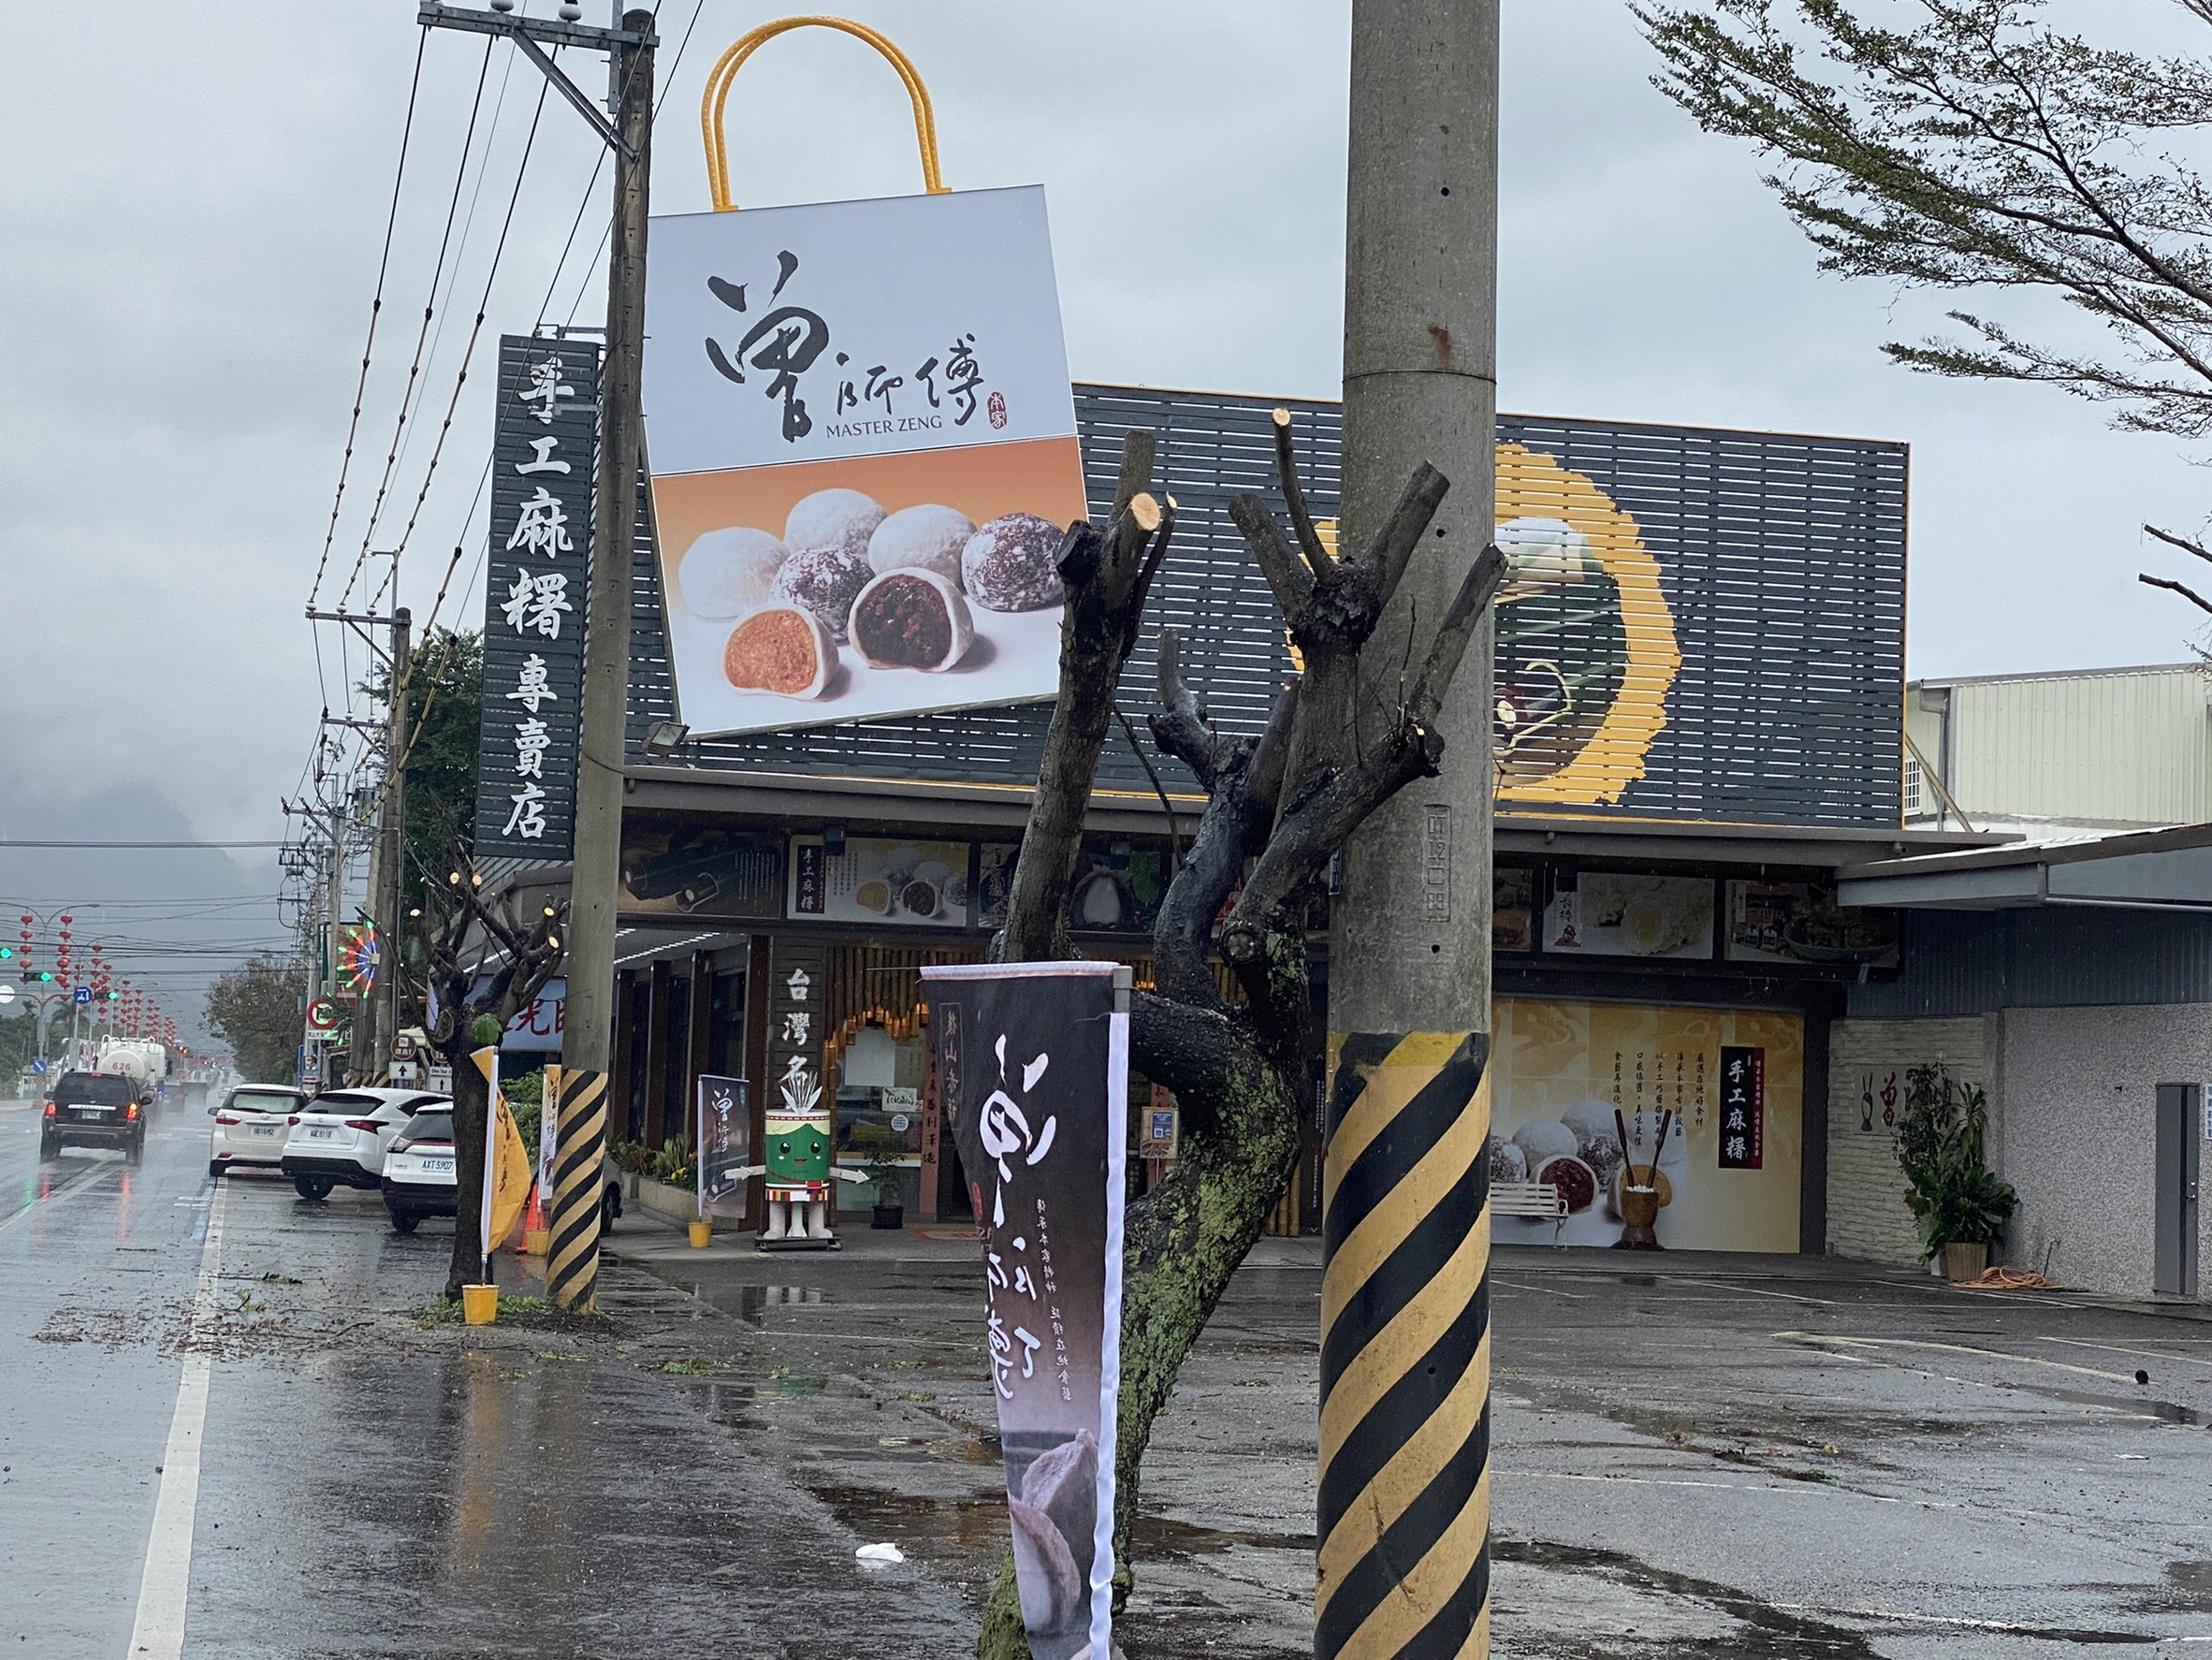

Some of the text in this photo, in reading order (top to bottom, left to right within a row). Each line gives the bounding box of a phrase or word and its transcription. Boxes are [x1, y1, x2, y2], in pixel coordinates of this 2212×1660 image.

[705, 250, 984, 444] 曾師傅
[826, 415, 942, 439] MASTER ZENG
[500, 354, 575, 838] 手工麻糬專賣店
[801, 848, 814, 910] 手工麻糬
[112, 1062, 131, 1070] 626
[779, 968, 810, 1110] 台灣名
[1725, 1059, 1747, 1160] 手工麻糬
